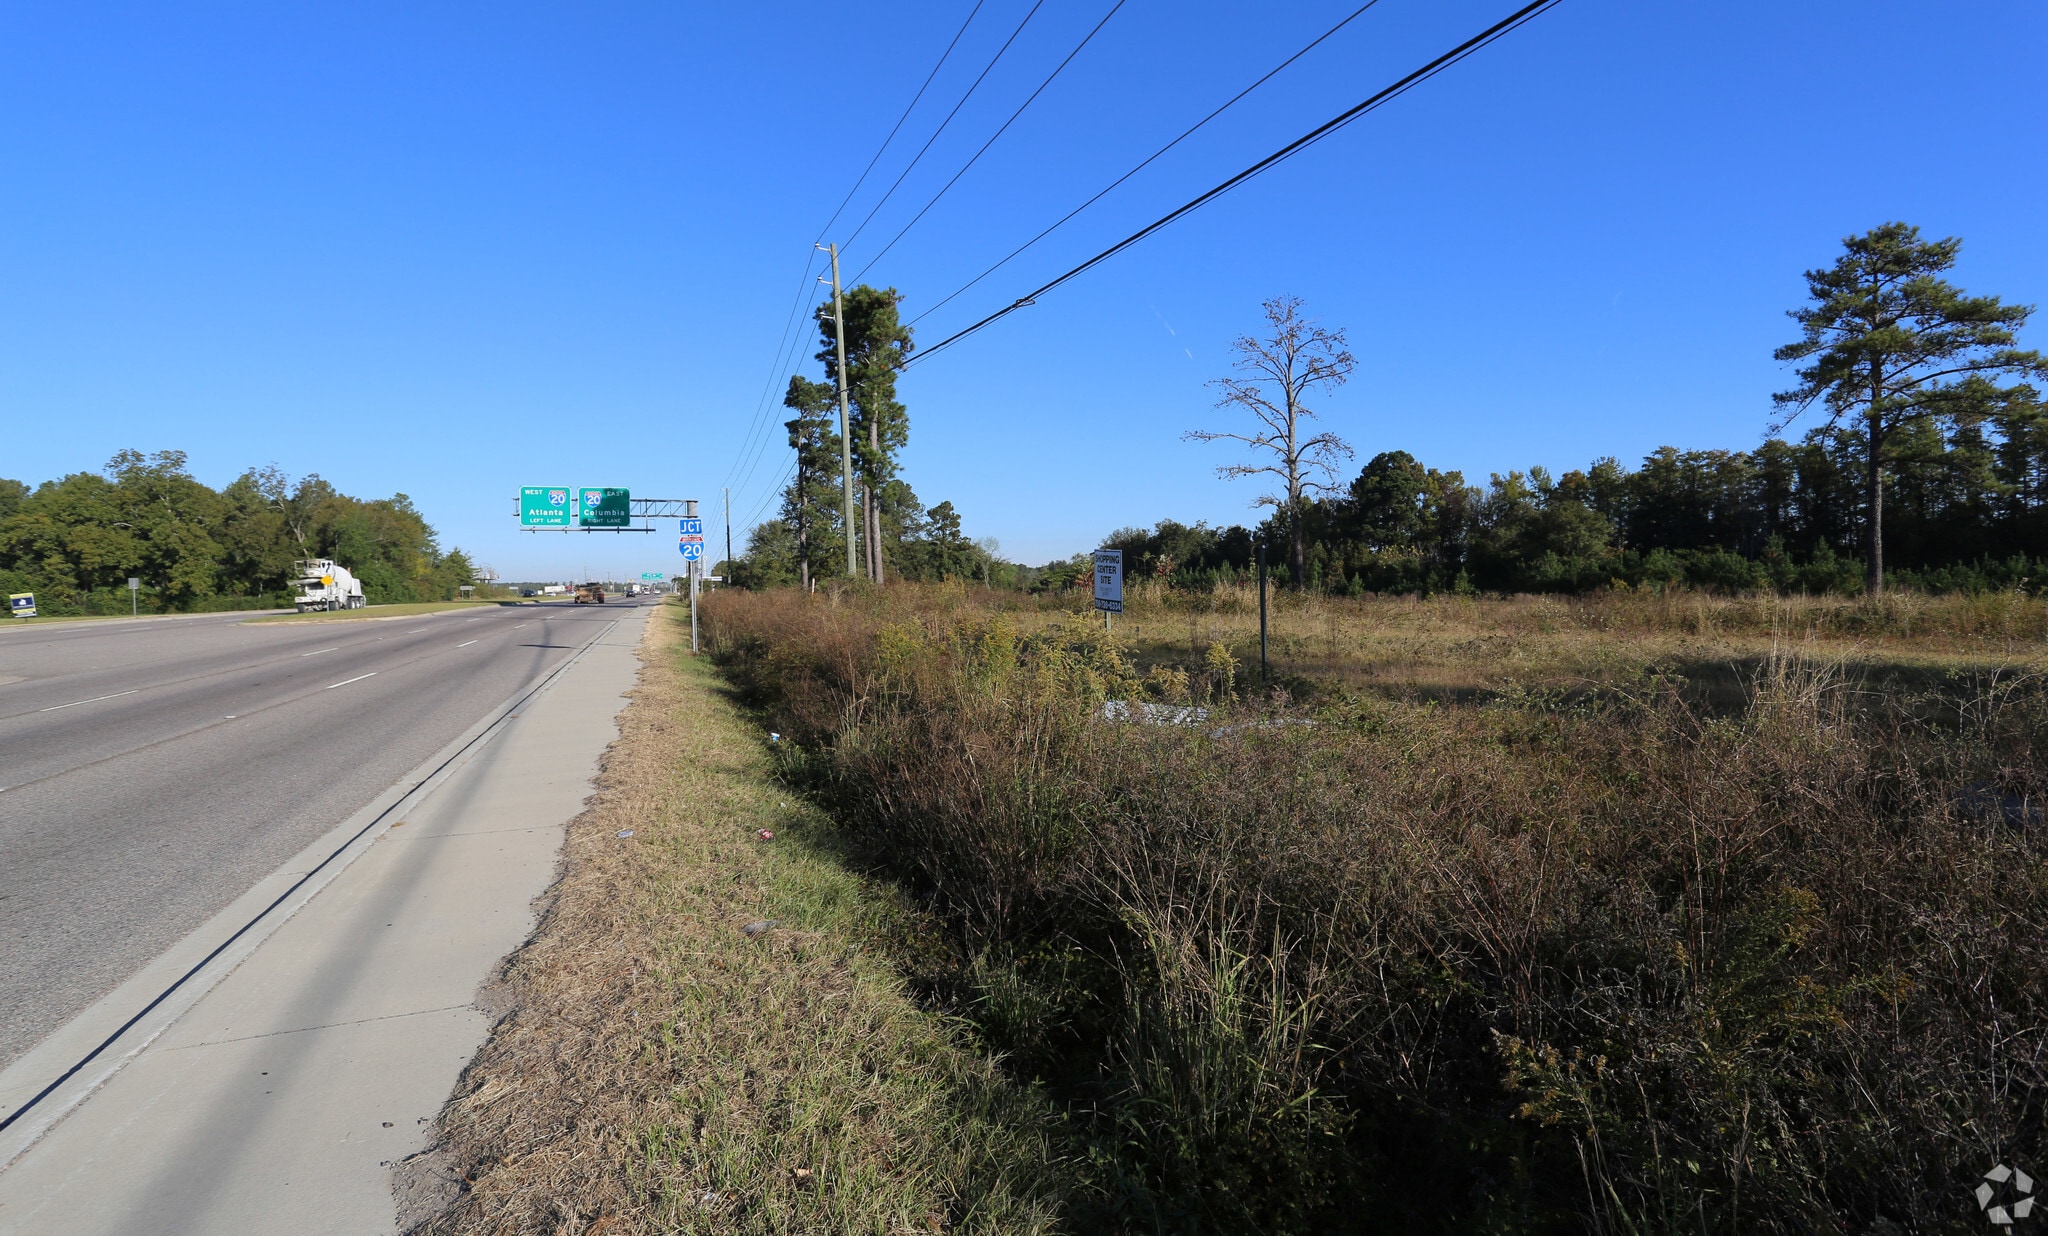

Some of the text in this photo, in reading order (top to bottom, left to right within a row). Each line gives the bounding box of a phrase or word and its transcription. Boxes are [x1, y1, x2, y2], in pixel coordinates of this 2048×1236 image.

[551, 494, 565, 503] 20
[588, 495, 600, 504] 20
[681, 521, 700, 532] JCT
[683, 545, 702, 556] 20
[1096, 554, 1120, 564] SHOPPING
[1097, 565, 1116, 574] CENTER
[1100, 576, 1112, 584] SITE
